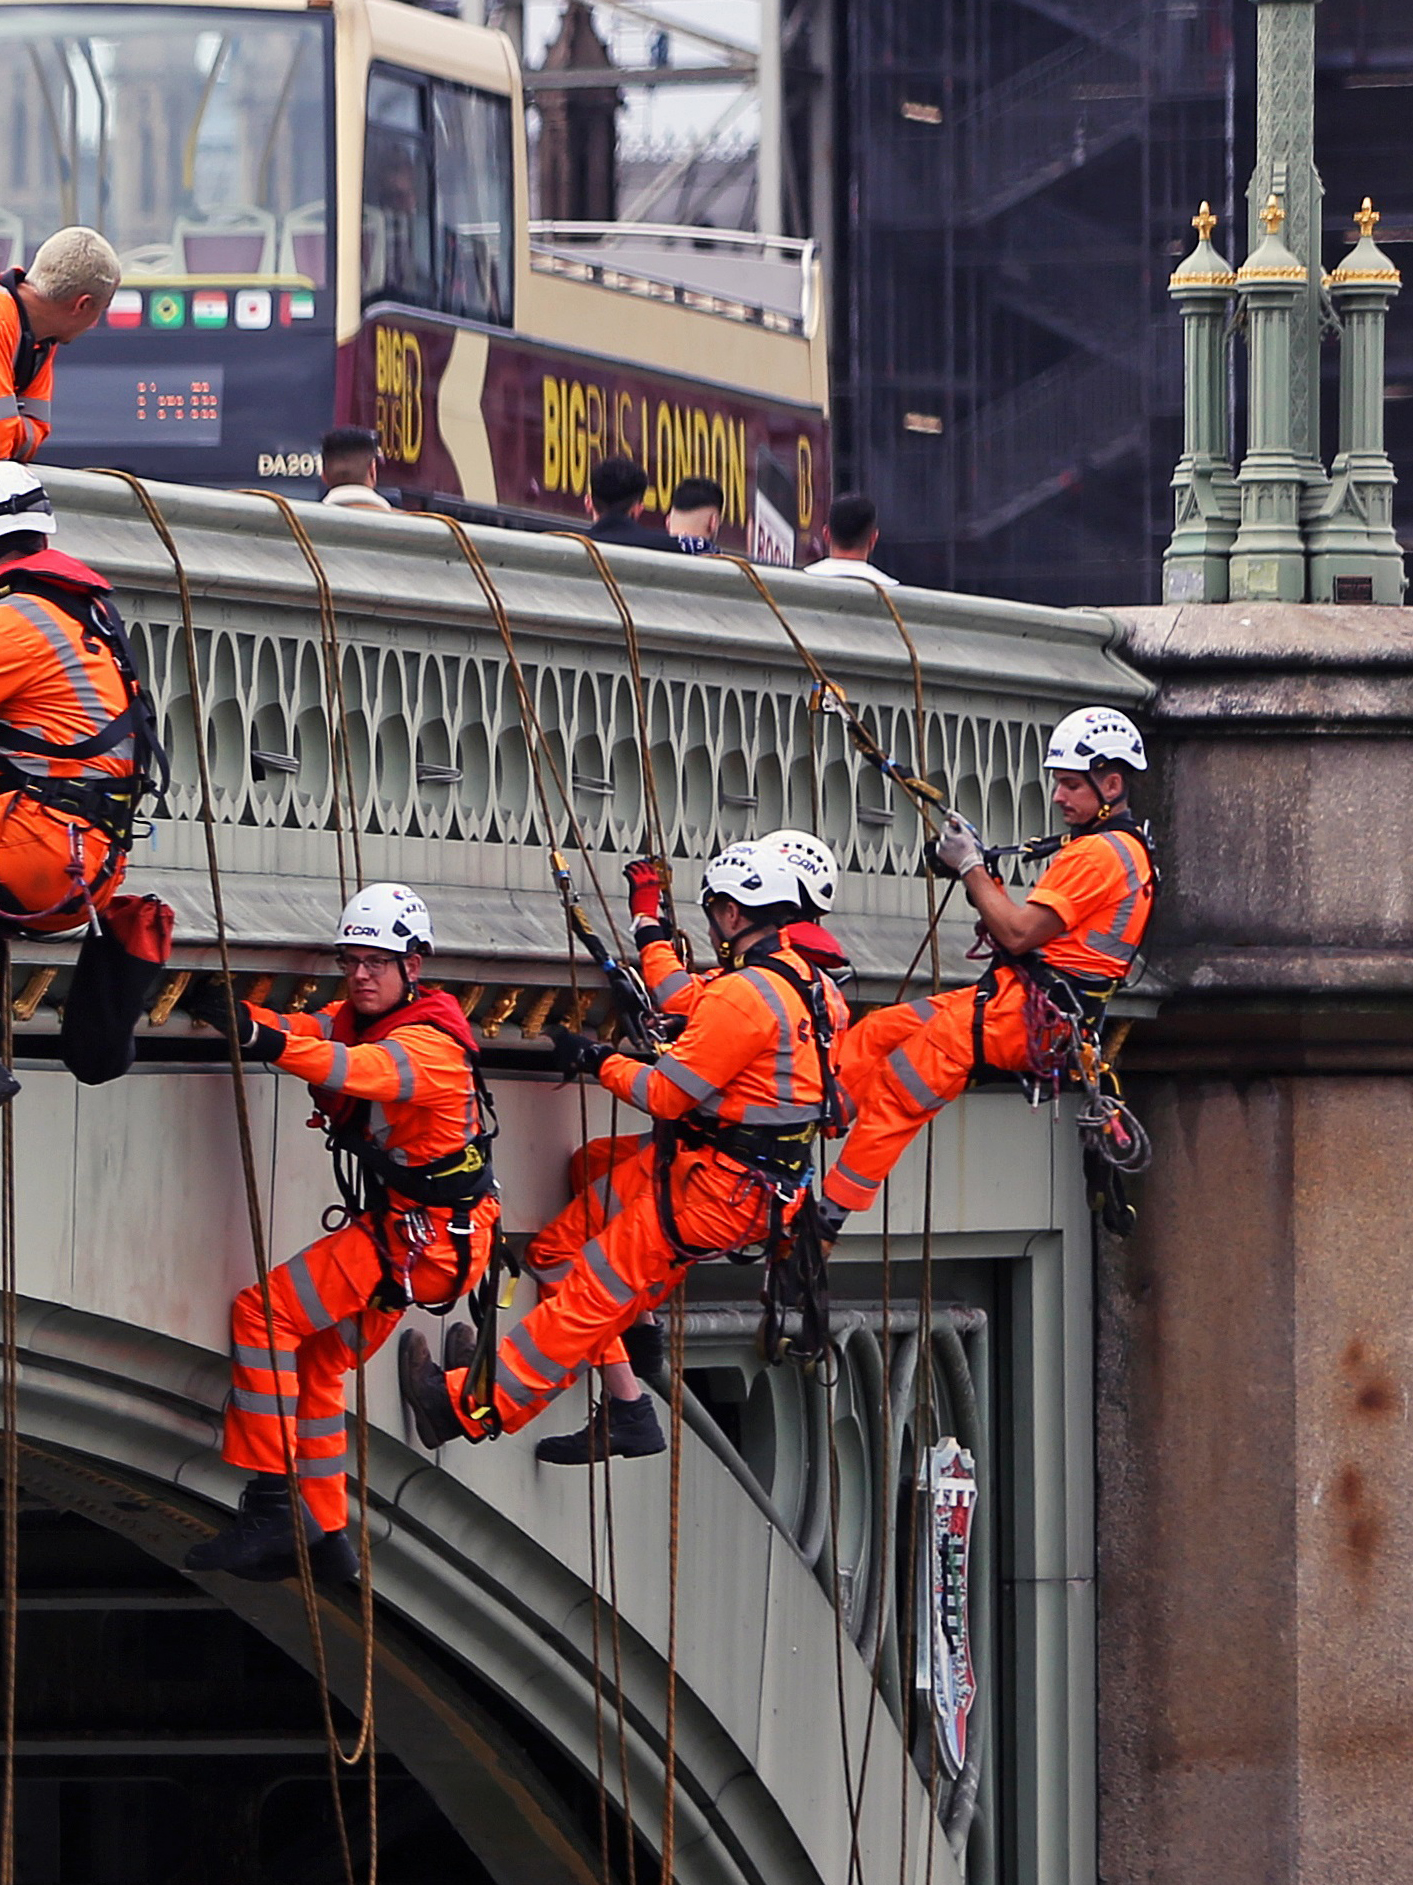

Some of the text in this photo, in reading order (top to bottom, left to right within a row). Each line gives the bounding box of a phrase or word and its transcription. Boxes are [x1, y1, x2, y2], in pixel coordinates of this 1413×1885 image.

[376, 325, 402, 397] BIG
[641, 396, 746, 530] LONDON
[788, 854, 820, 876] CAN
[352, 925, 380, 937] CAN
